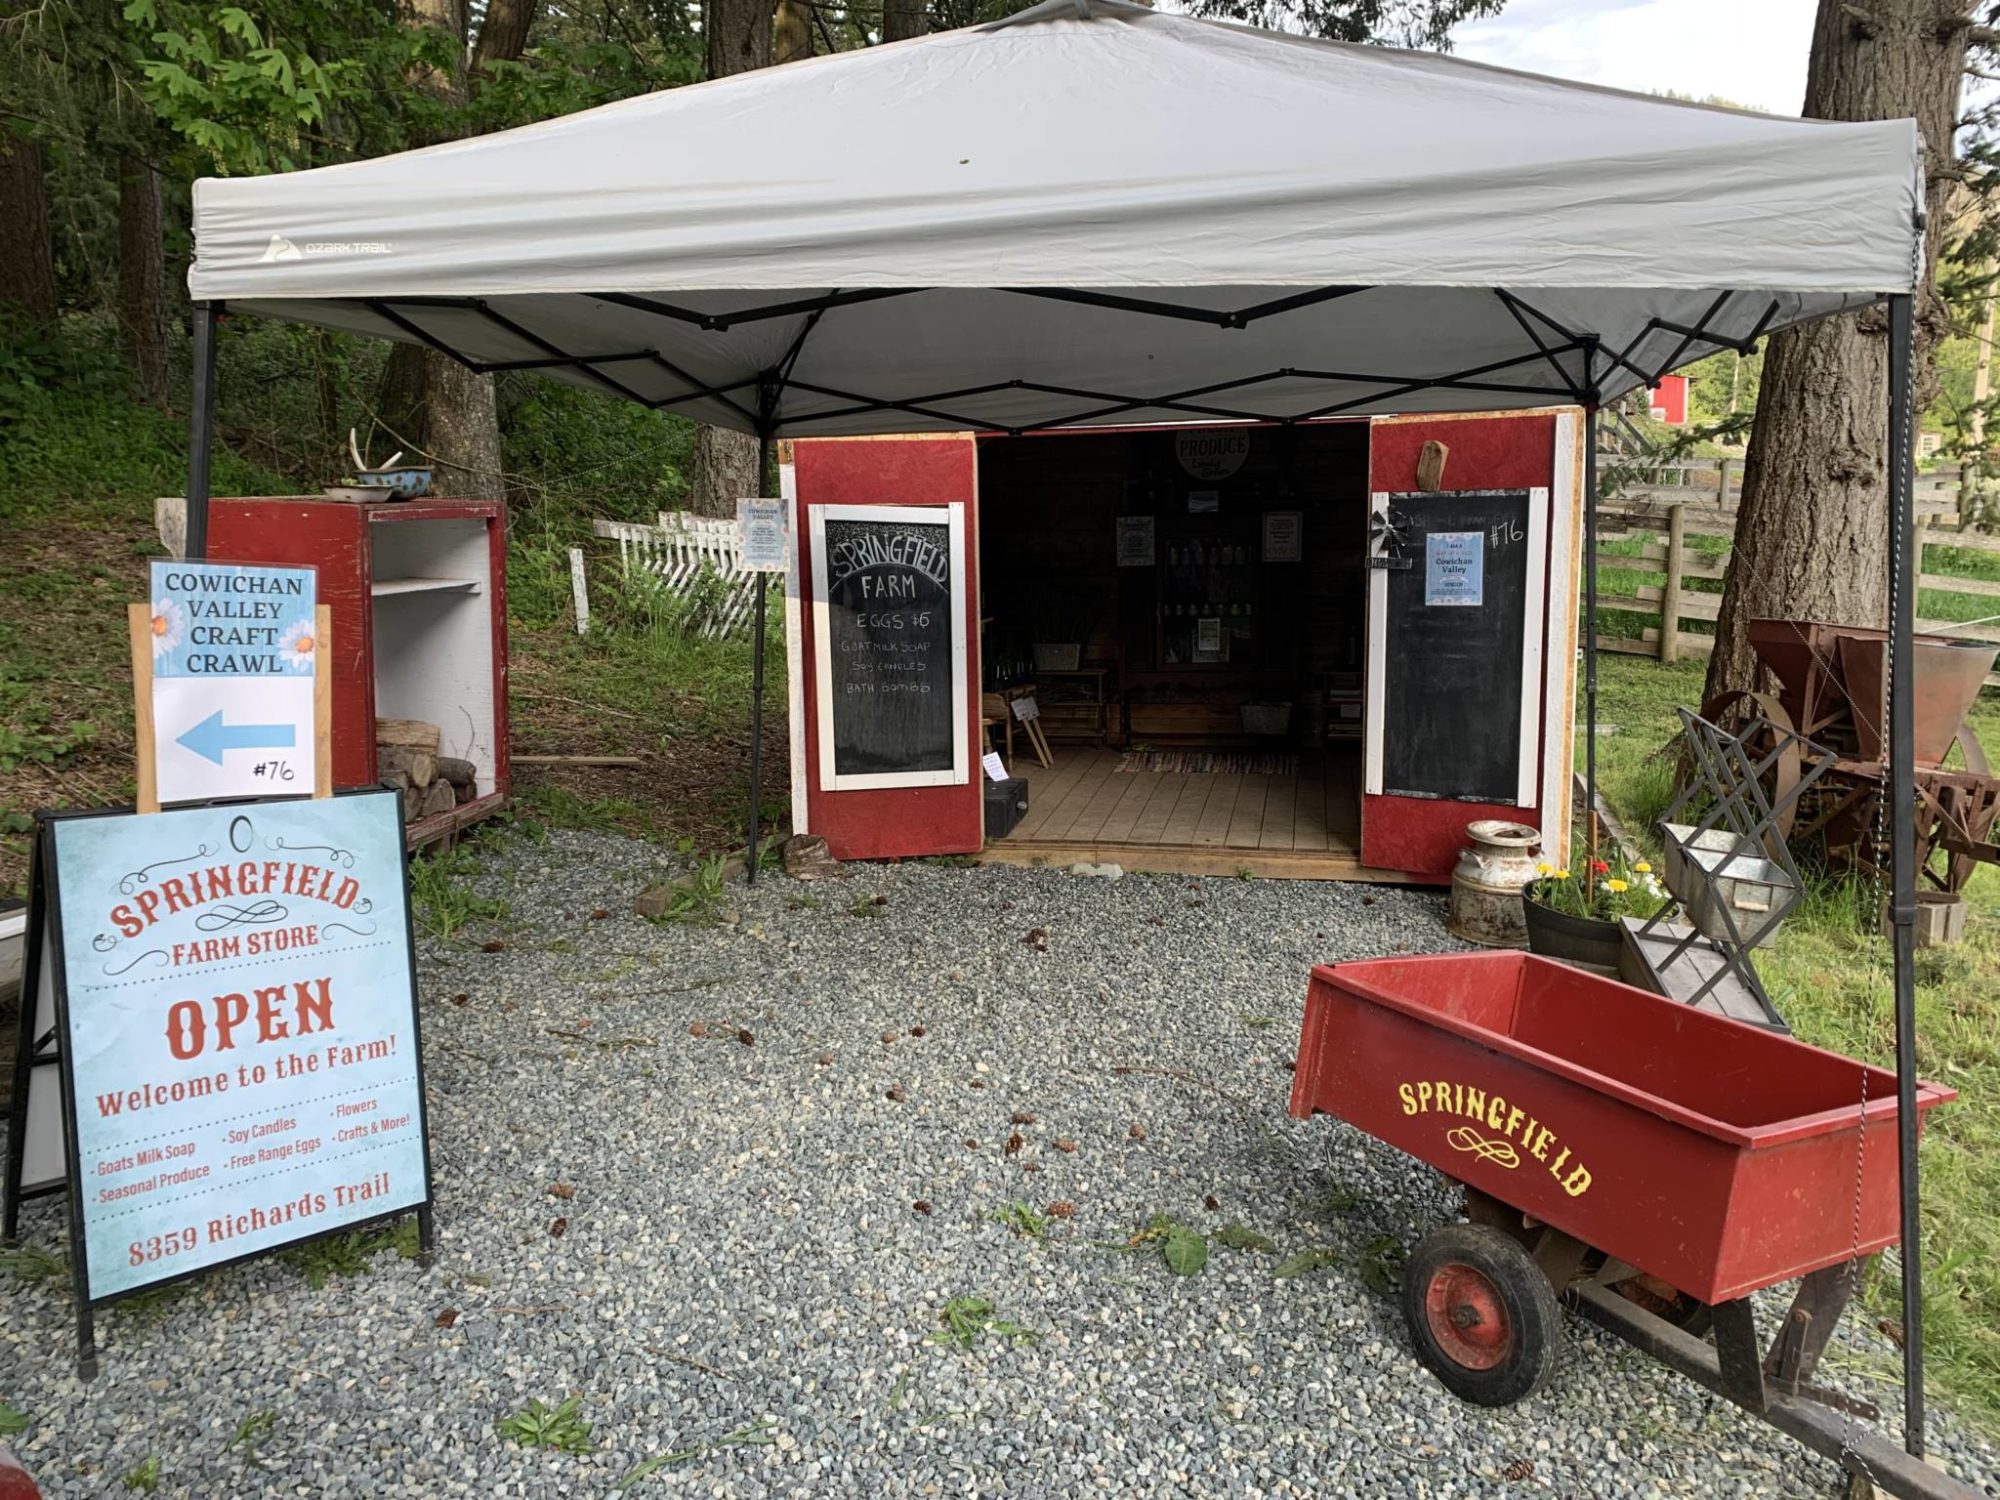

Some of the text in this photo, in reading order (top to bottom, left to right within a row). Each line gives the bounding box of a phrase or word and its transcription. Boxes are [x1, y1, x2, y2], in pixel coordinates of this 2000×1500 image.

[1180, 437, 1245, 457] PRODUCE
[1490, 519, 1524, 548] #76
[832, 533, 949, 583] SPRINGFIELD
[1442, 566, 1467, 574] Valley
[165, 573, 303, 595] COWICHAN
[861, 575, 916, 598] FARM
[187, 600, 284, 619] VALLEY
[857, 613, 904, 629] EGGS
[190, 626, 278, 645] CRAFT
[900, 641, 931, 652] SOAP
[187, 654, 283, 673] CRAWL
[847, 682, 874, 693] BATH
[253, 761, 295, 780] #76
[110, 862, 359, 938] SPRINGFIELD
[172, 924, 319, 966] FARM STORE
[165, 977, 335, 1060] OPEN
[96, 1034, 397, 1118] Welcome to the Farm!
[336, 1099, 378, 1118] Flowers
[228, 1117, 296, 1145] Soy Candles
[338, 1113, 411, 1143] Crafts & More!
[1399, 1081, 1592, 1197] SPRINGFIELD
[97, 1142, 196, 1177] Goats Milk Soap
[230, 1136, 321, 1169] Free Range Eggs
[98, 1165, 210, 1203] Seasonal Produce
[128, 1171, 391, 1267] 8359 Richards Trail
